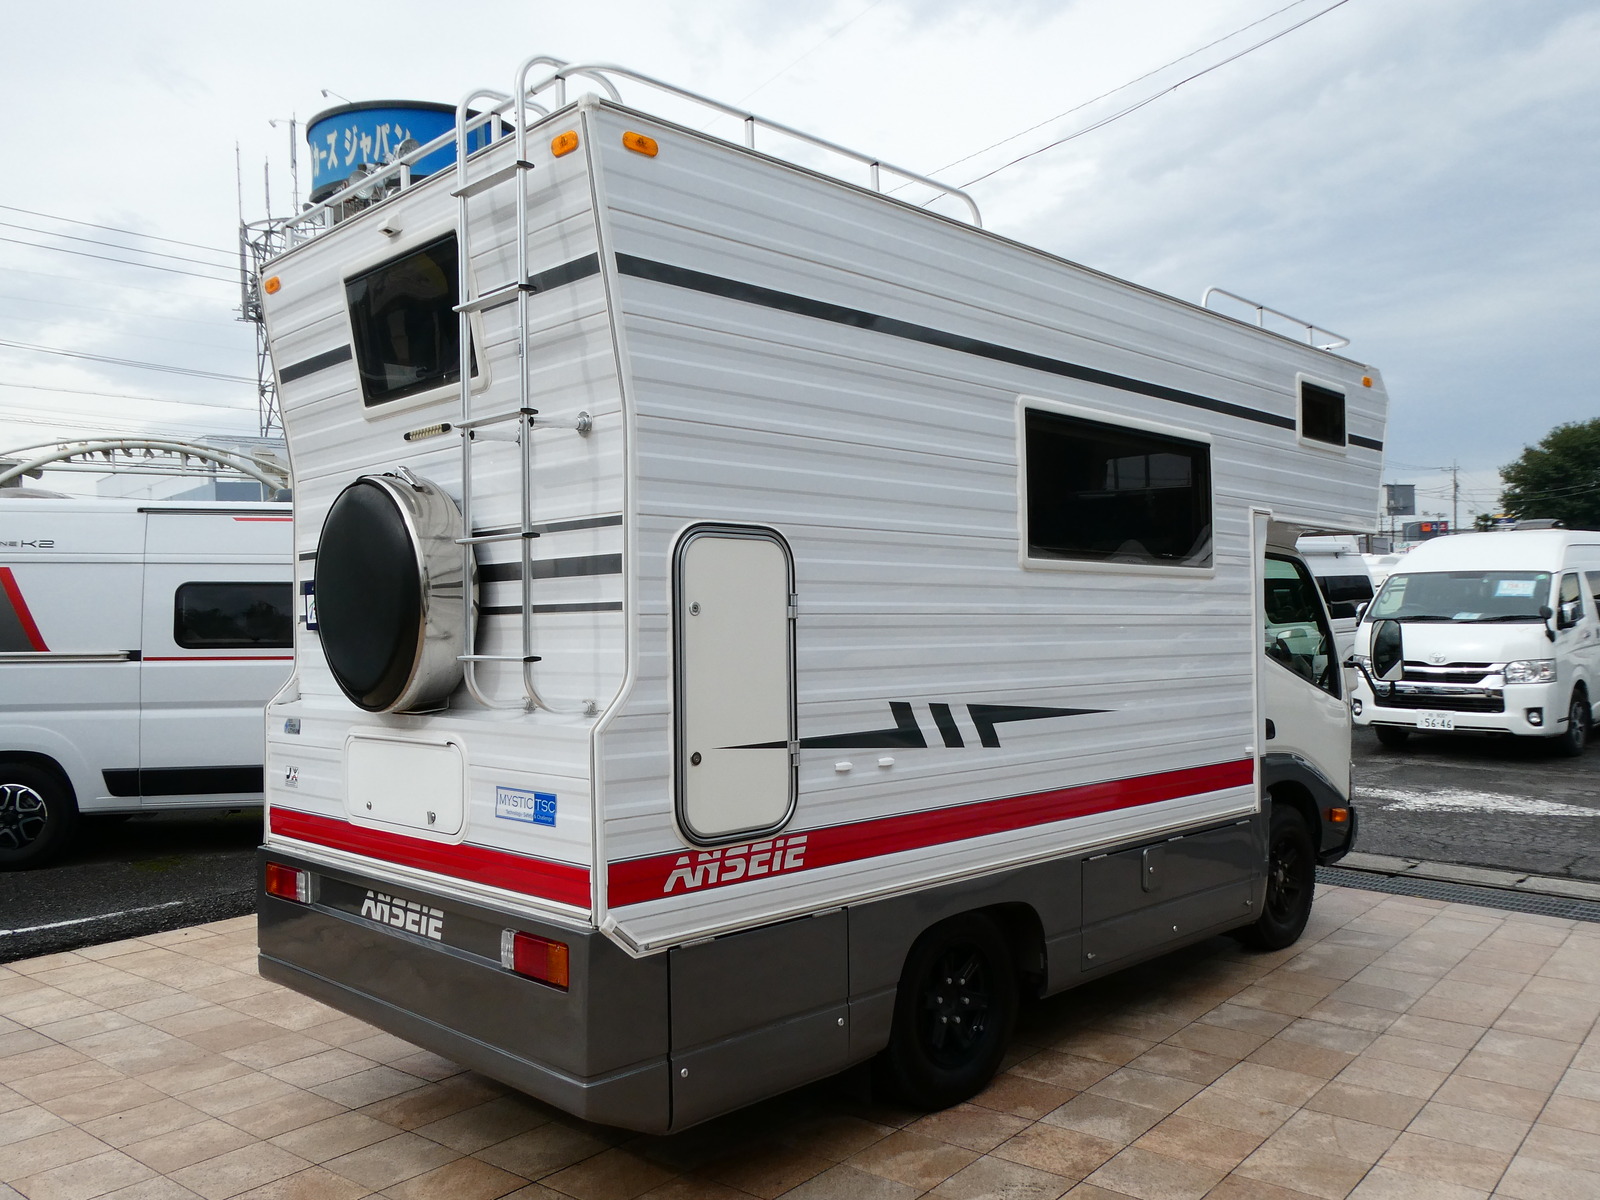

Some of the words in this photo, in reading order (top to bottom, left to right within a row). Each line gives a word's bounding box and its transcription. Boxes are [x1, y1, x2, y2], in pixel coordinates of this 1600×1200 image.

[1424, 718, 1452, 728] 56-46
[499, 794, 533, 809] MYSTIC
[535, 799, 555, 813] TSC
[663, 835, 808, 893] ANSEIE
[361, 890, 444, 940] ANSEIE
